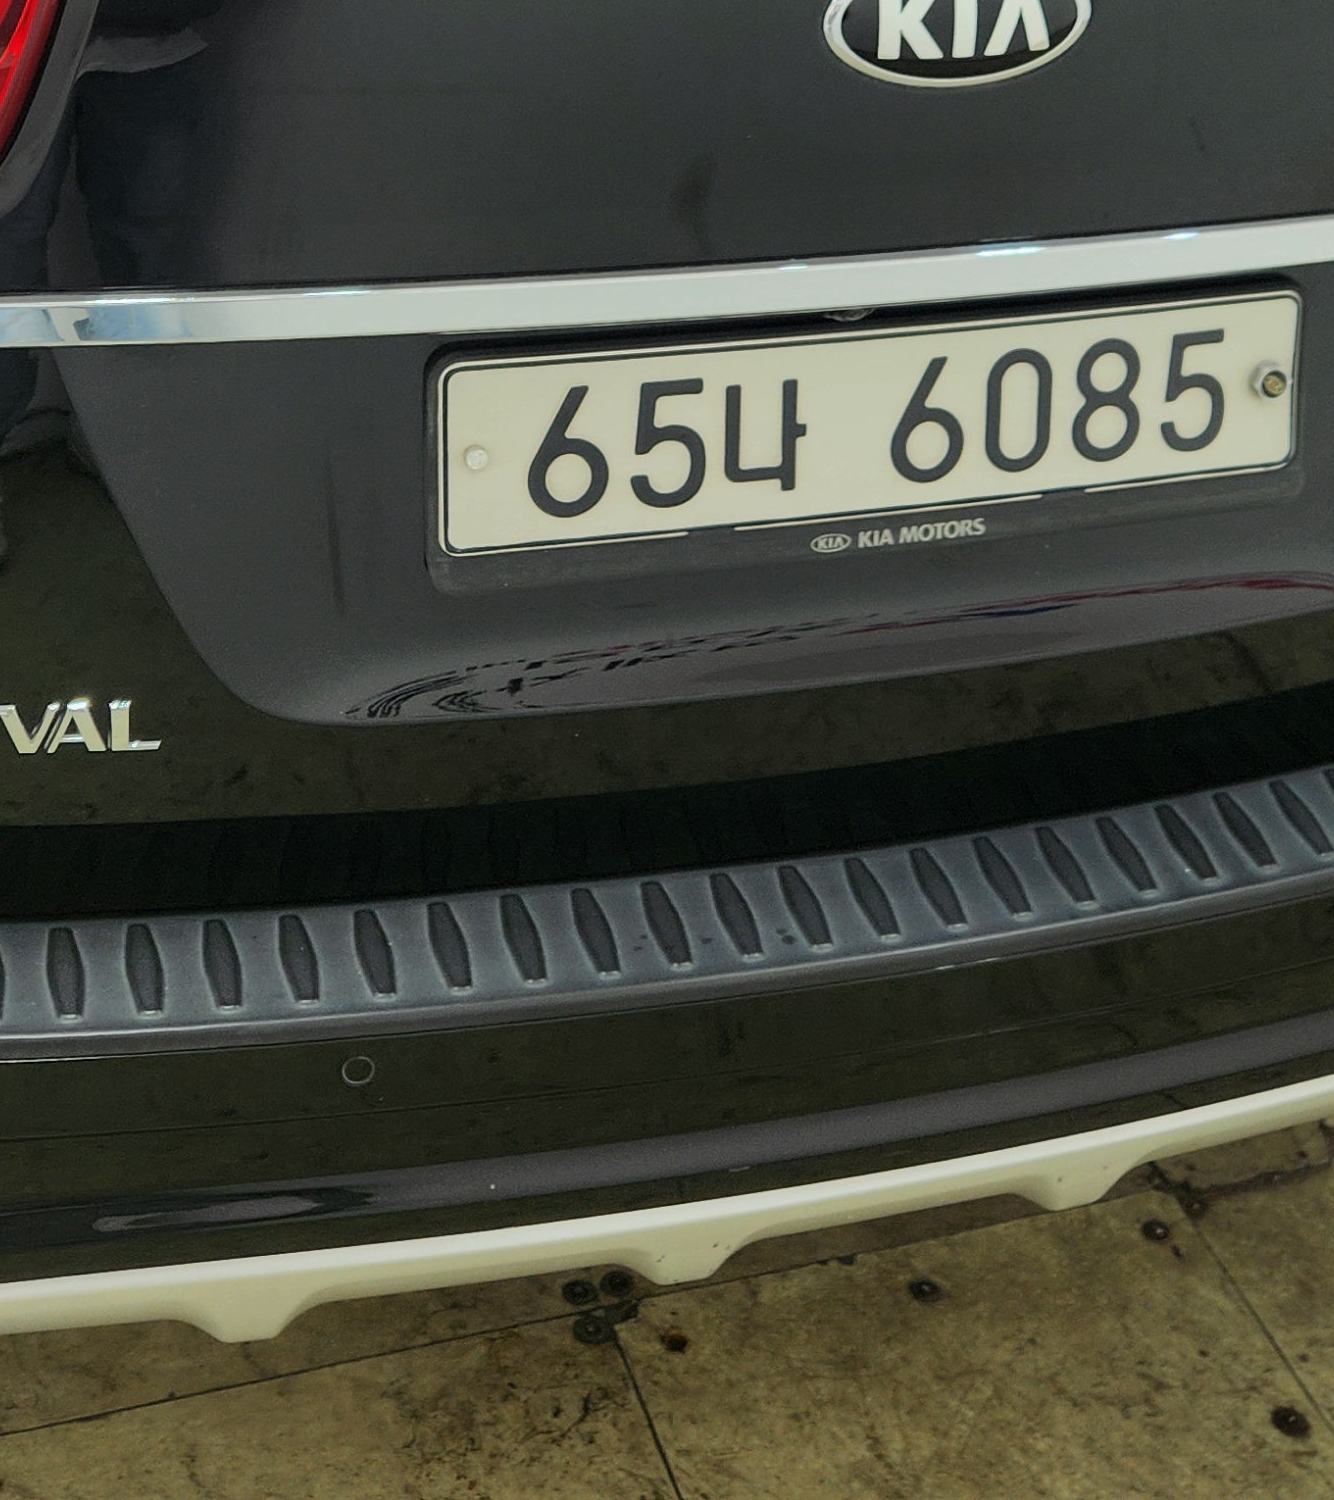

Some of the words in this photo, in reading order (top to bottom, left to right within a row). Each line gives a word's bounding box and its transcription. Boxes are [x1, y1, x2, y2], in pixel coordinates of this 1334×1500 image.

[527, 377, 807, 519] 65나
[890, 328, 1226, 483] 6085
[857, 528, 894, 549] KIA
[898, 517, 987, 544] MOTORS
